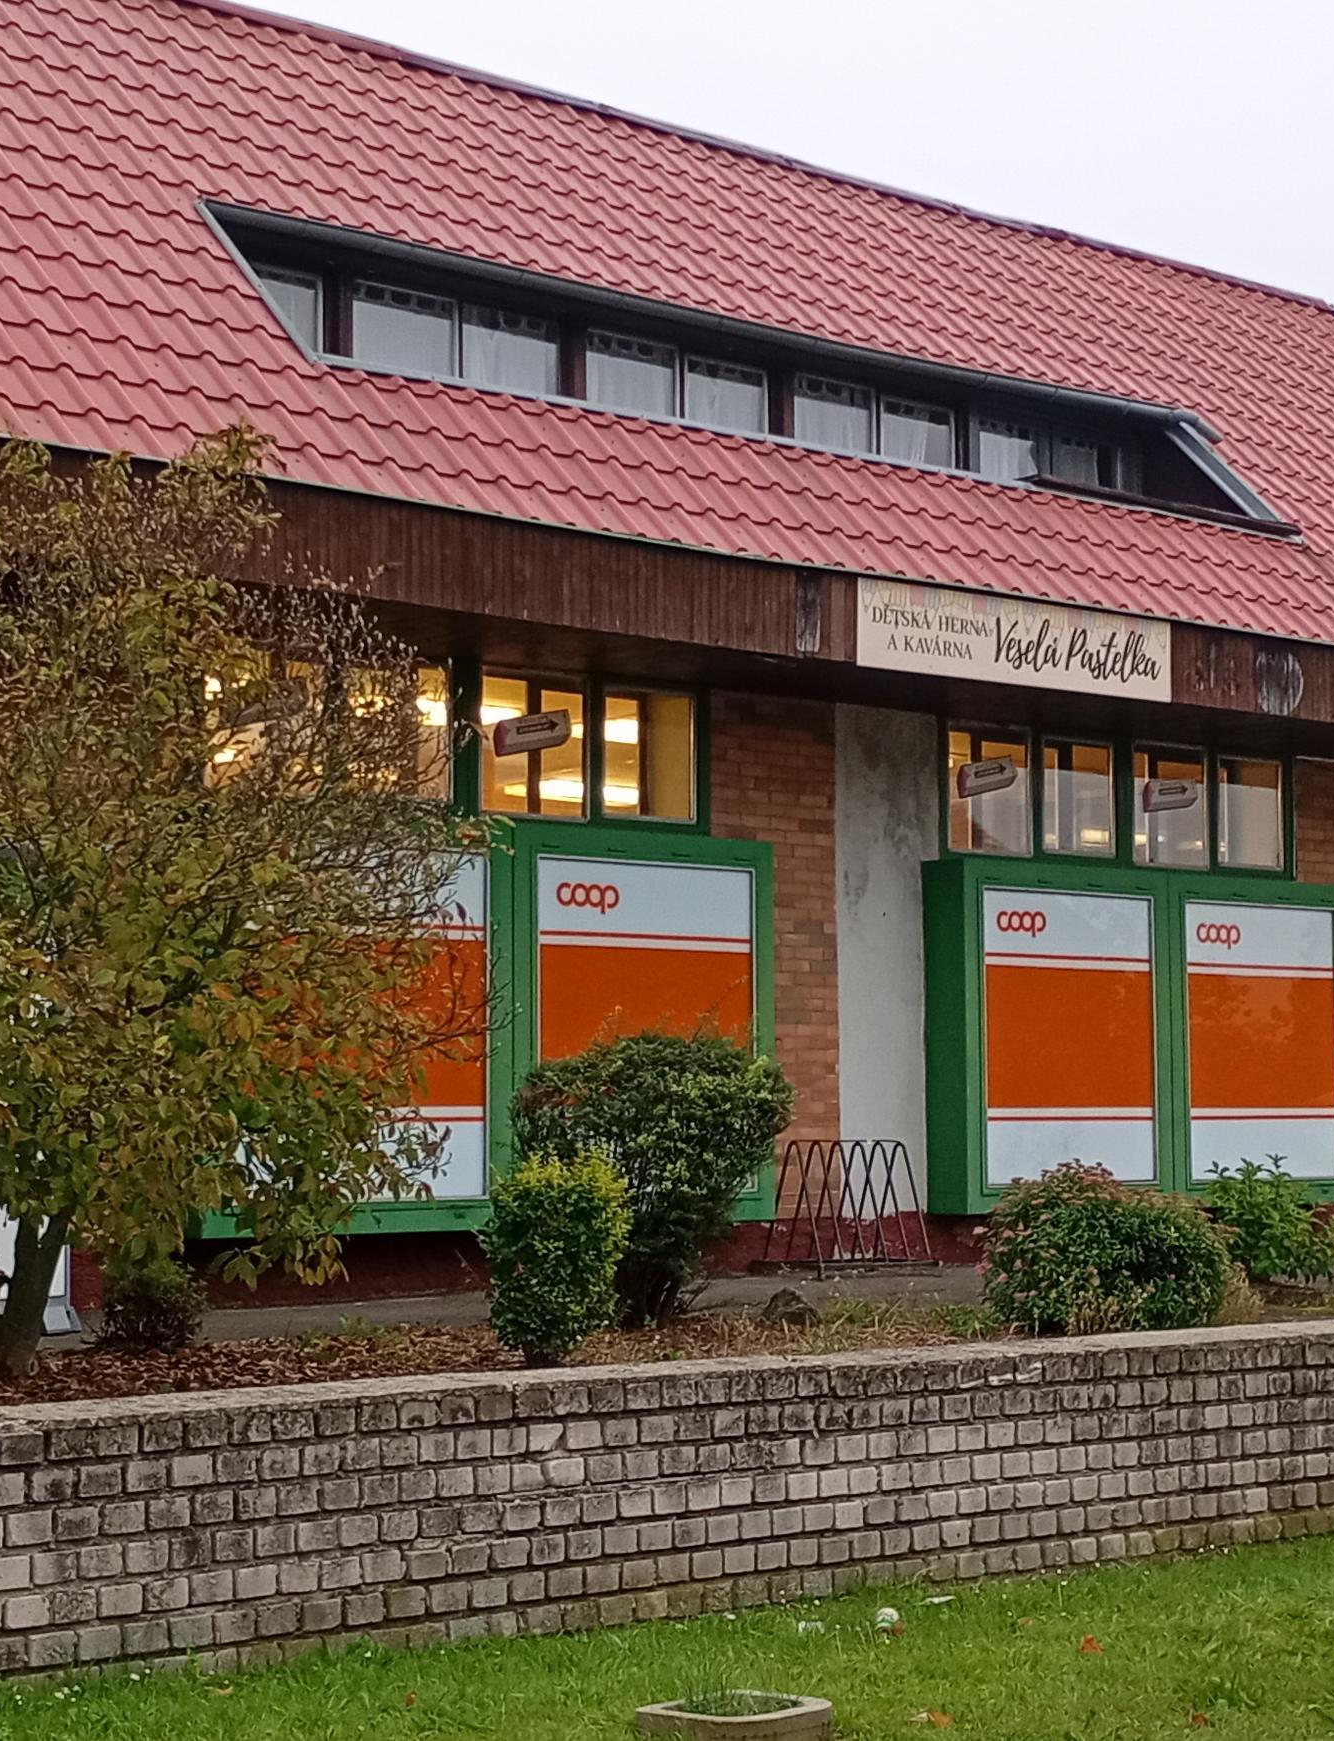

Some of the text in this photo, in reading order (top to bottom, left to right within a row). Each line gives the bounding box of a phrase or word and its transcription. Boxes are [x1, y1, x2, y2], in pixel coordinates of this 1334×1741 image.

[871, 602, 989, 637] DĚTSKÁ HERNA
[887, 633, 973, 660] A KAVÁRNA
[994, 616, 1162, 683] Veselá Pastelka
[556, 882, 620, 915] coop
[996, 910, 1047, 938] coop
[1196, 922, 1241, 950] coop
